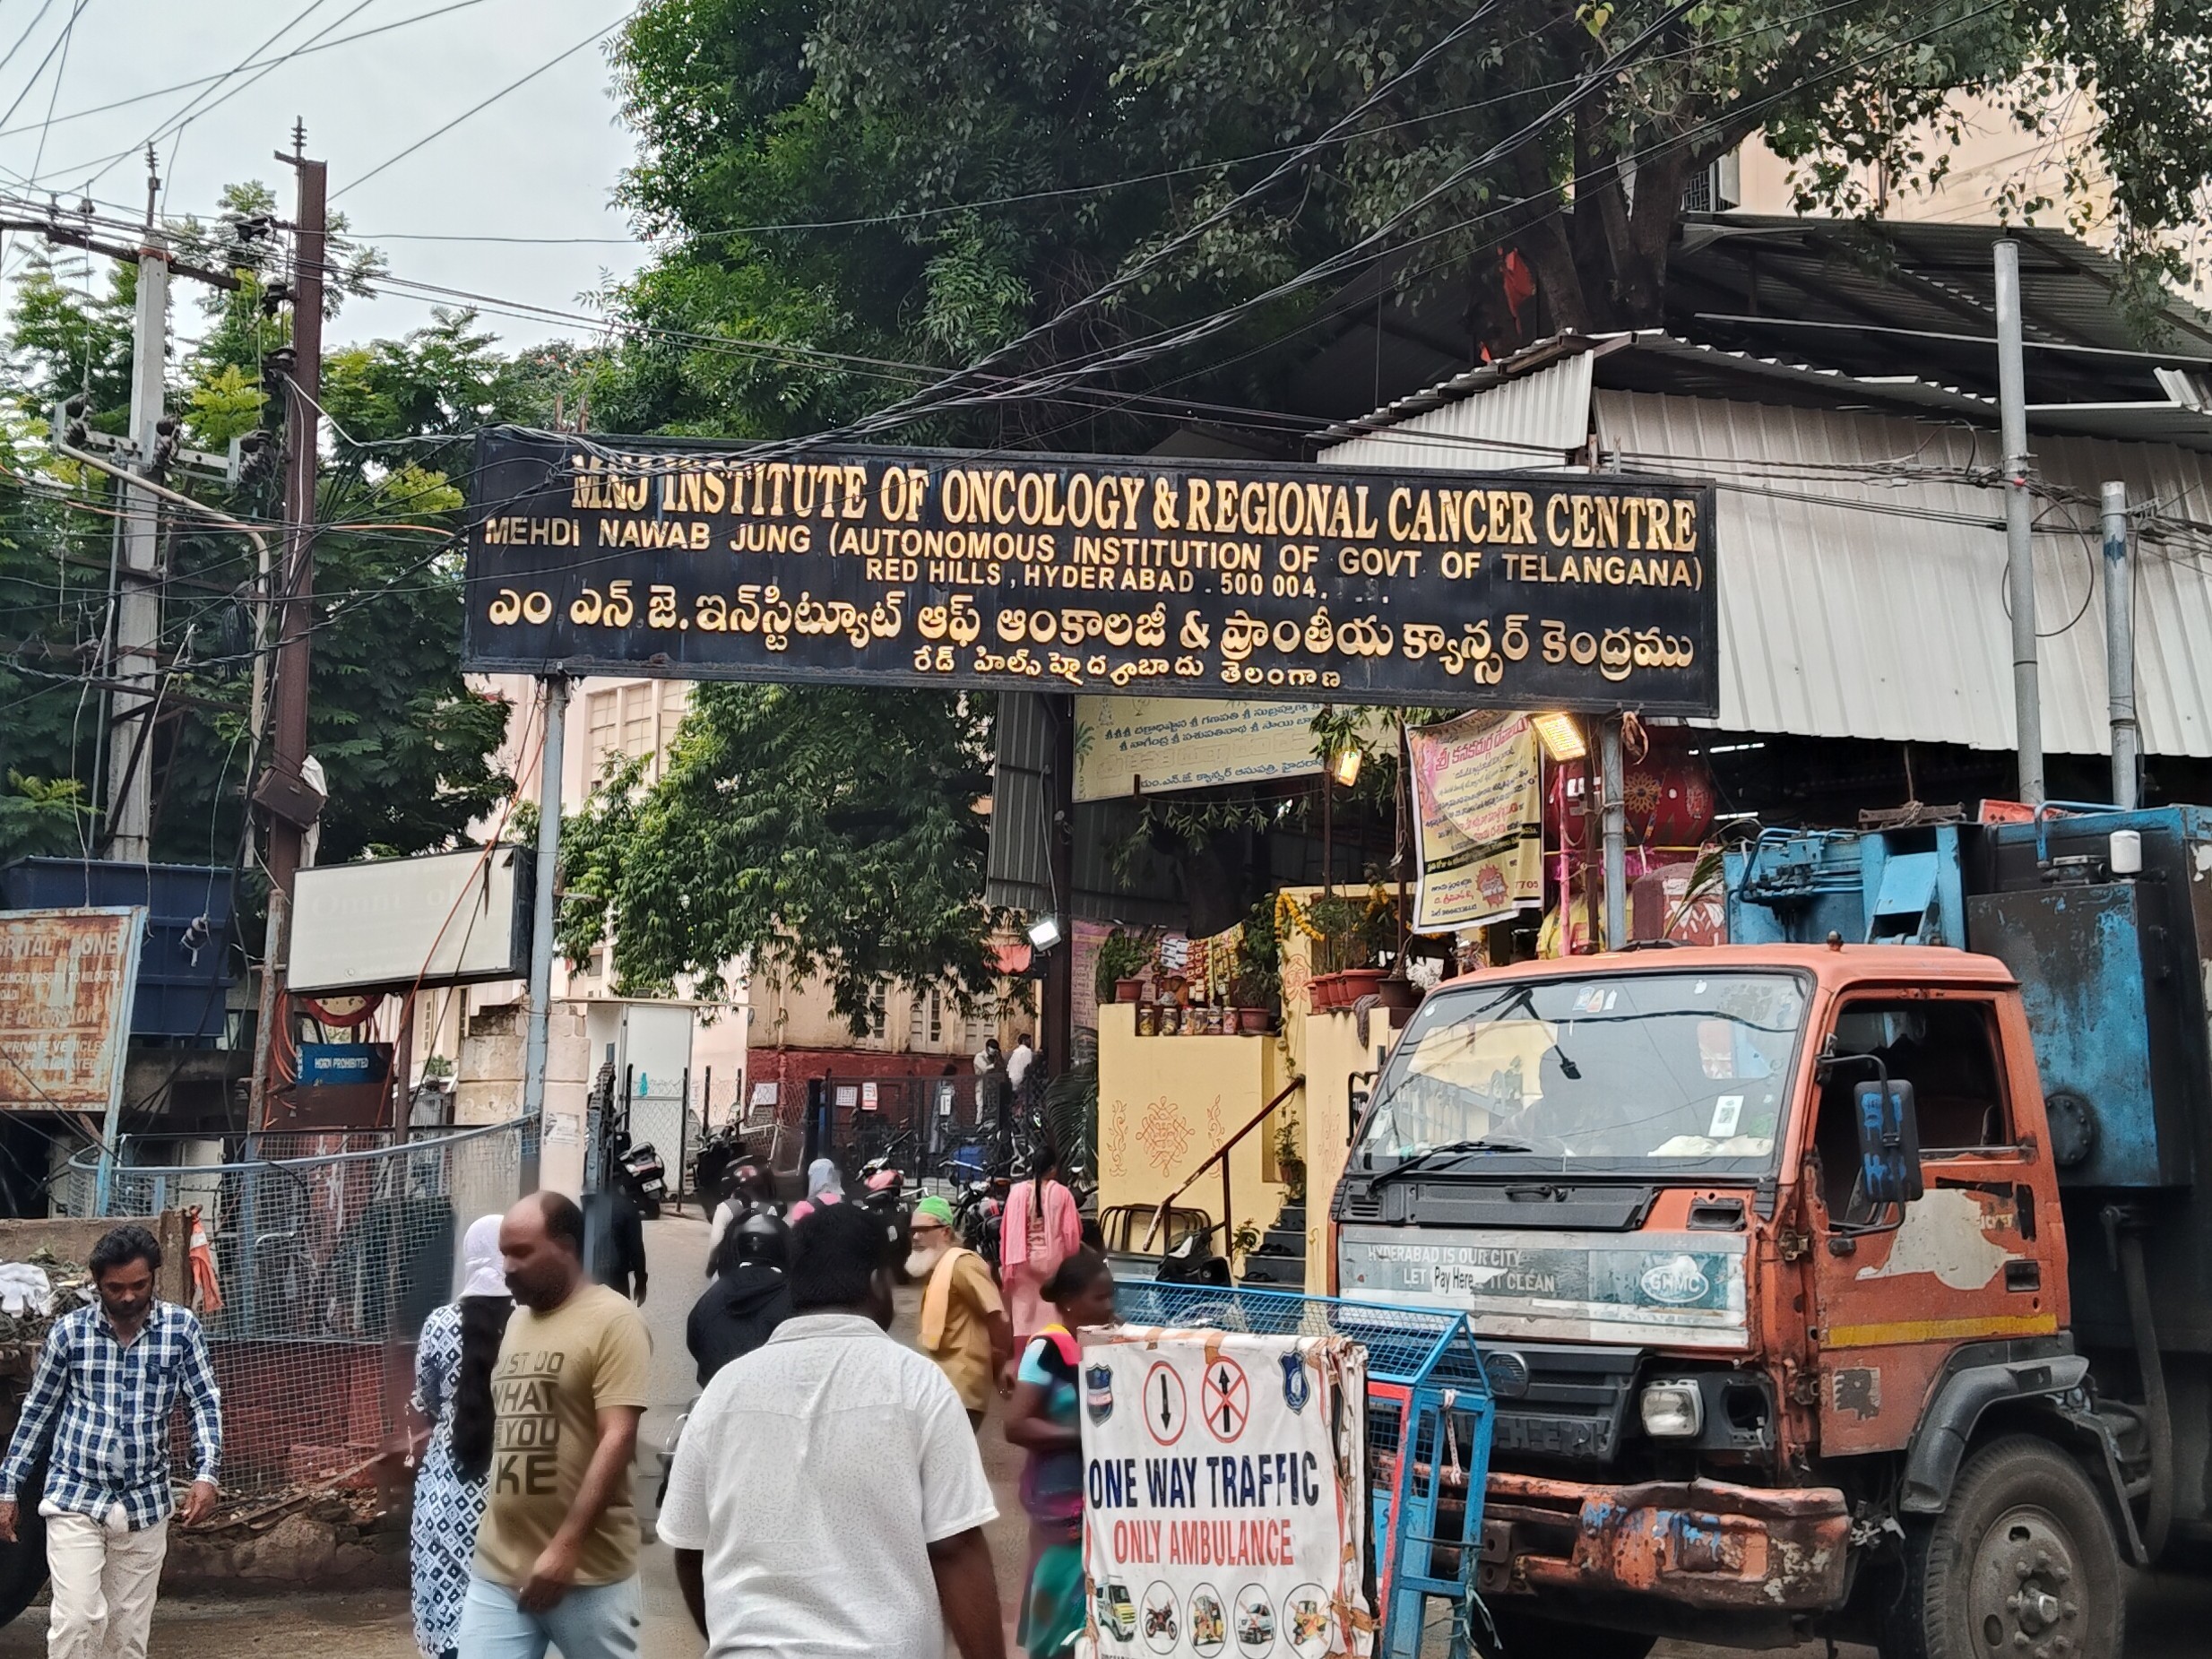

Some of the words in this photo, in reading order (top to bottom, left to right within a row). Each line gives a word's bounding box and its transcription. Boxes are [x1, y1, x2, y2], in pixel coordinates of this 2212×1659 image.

[661, 459, 868, 520] INSTITUTE
[880, 466, 930, 523] OF
[942, 469, 1145, 531] ONCOLOGY
[1153, 476, 1180, 531] &
[1186, 478, 1378, 540] REGIONAL
[1387, 488, 1537, 545] CANCER
[1544, 493, 1698, 553] CENTRE
[484, 517, 581, 547] MEHDI
[598, 520, 711, 550] NAWAB
[730, 523, 811, 553] JUNG
[830, 522, 1055, 563] (AUTONOMOUS
[1074, 537, 1261, 569] INSTITUTION
[1279, 546, 1319, 575] OF
[1338, 547, 1422, 578] GOVT
[1440, 551, 1482, 580] OF
[1502, 553, 1702, 592] TELANGANA)
[866, 557, 918, 583] RED
[1024, 564, 1195, 593] HYDERABAD
[1221, 574, 1264, 597] 500
[488, 588, 553, 626] ఎం
[570, 579, 635, 627] ఎన్
[918, 593, 981, 648] ఆఫ్
[997, 601, 1167, 647] ఆంకాలజీ
[1179, 609, 1210, 649] &
[1220, 604, 1395, 661] ప్రాంతీయ
[1402, 614, 1530, 686] క్యాన్సర్
[1368, 1245, 1439, 1263] HYDERABAD
[1442, 1248, 1451, 1264] IS
[1460, 1249, 1488, 1266] OUR
[1490, 1249, 1523, 1266] CITY
[1404, 1268, 1427, 1284] LET
[1434, 1266, 1451, 1293] Pay
[1453, 1266, 1473, 1290] Here
[1507, 1273, 1555, 1292] CLEAN
[1649, 1272, 1701, 1293] GHMC
[505, 1418, 560, 1447] YOU
[1089, 1457, 1138, 1509] ONE
[1145, 1456, 1197, 1508] WAY
[1206, 1450, 1319, 1508] TRAFFIC
[1113, 1518, 1162, 1565] ONLY
[1169, 1518, 1294, 1567] AMBULANCE
